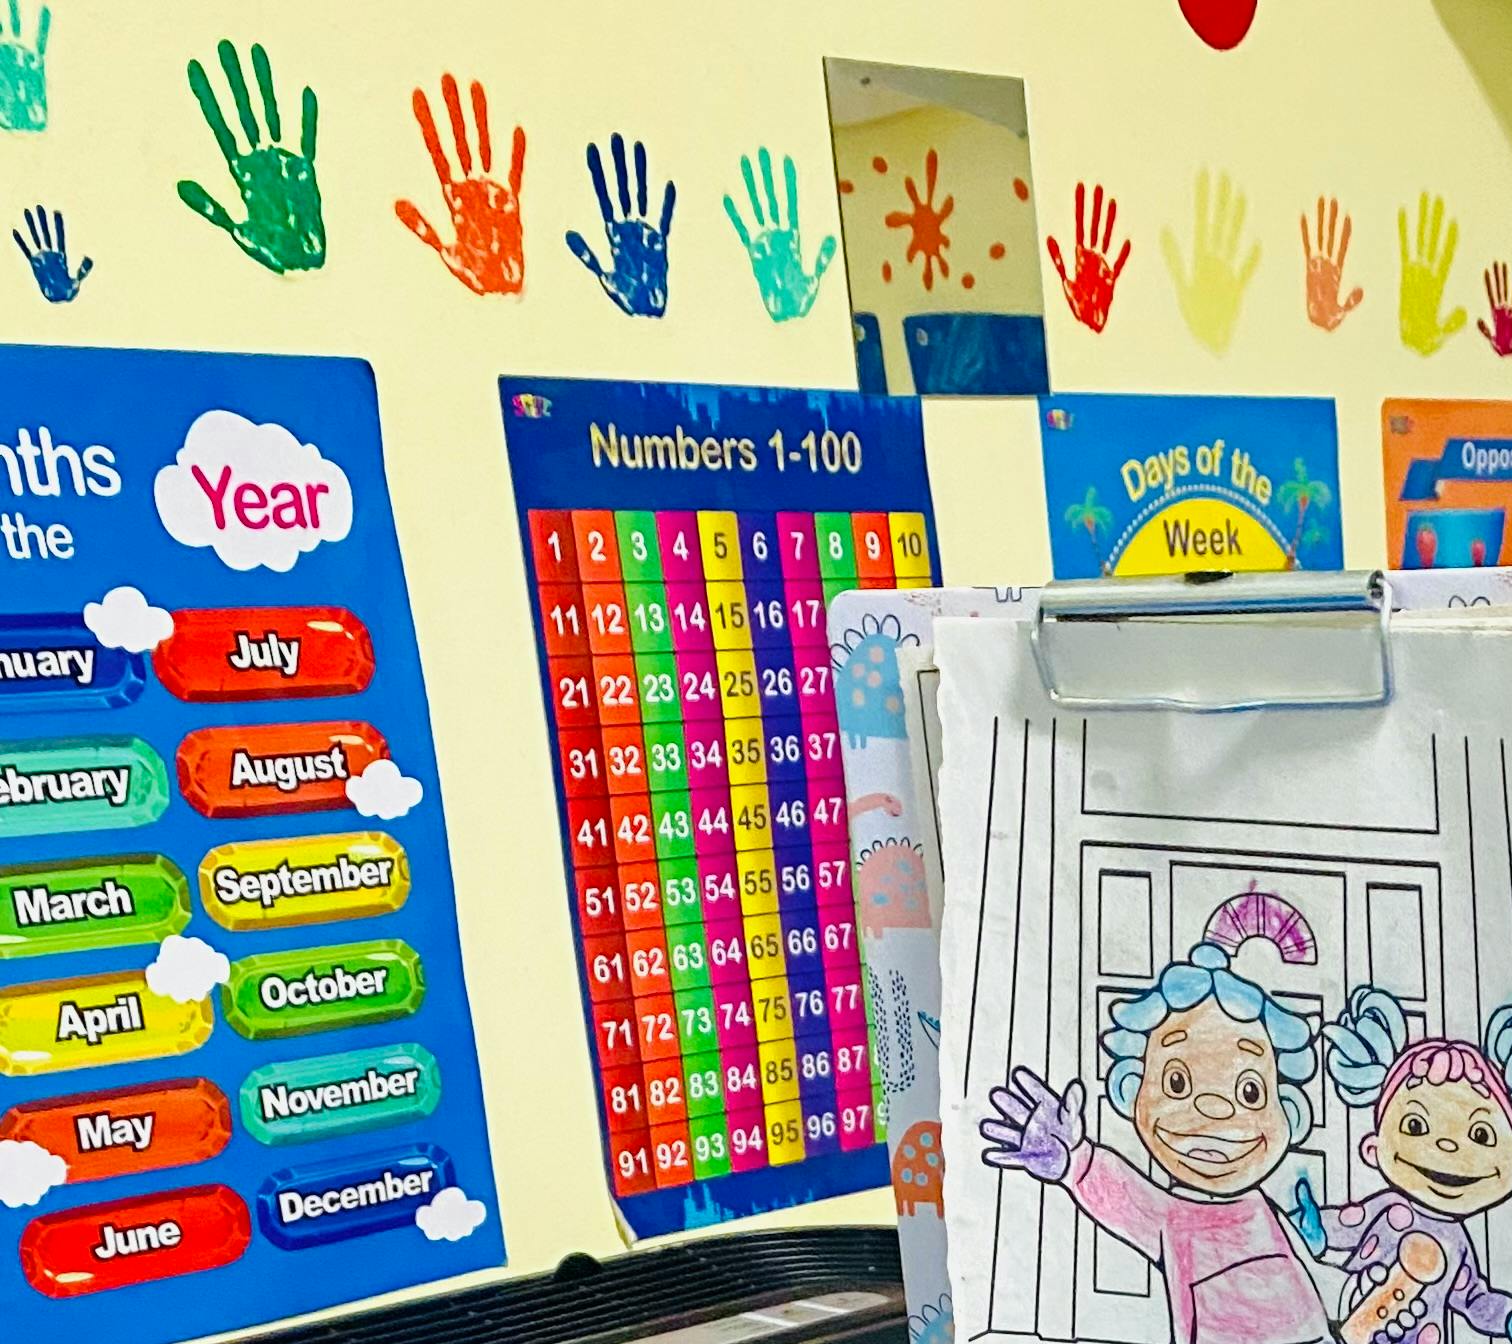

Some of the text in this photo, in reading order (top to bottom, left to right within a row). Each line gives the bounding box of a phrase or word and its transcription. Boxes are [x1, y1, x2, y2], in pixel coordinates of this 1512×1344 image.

[589, 422, 863, 474] Numbers 1-100
[1120, 438, 1273, 506] Days of the
[191, 465, 330, 530] Year
[0, 511, 75, 559] the
[547, 531, 922, 562] 1 2 3 4 5 6 7 8 9 10
[1163, 518, 1243, 558] Week
[550, 599, 820, 635] 11 12 13 14 15 16 17
[230, 634, 299, 673] July
[559, 666, 830, 708] 21 22 23 24 25 26 27
[231, 747, 347, 790] August
[569, 732, 836, 779] 31 32 33 34 35 36 37
[577, 797, 842, 848] 41 42 43 44 45 46 47
[14, 883, 132, 924] March
[217, 858, 392, 906] September
[585, 860, 846, 917] 51 52 53 54 55 56 57
[593, 922, 852, 983] 61 62 63 64 65 66 67
[260, 967, 386, 1009] October
[57, 996, 142, 1043] April
[602, 984, 859, 1049] 71 72 73 74 75 76 77
[260, 1067, 418, 1119] November
[611, 1083, 641, 1113] 81
[649, 1077, 681, 1107] 82
[689, 1070, 720, 1100] 83
[727, 1063, 757, 1092] 84
[765, 1058, 794, 1084] 85
[801, 1050, 831, 1081] 86
[837, 1045, 865, 1073] 87
[77, 1114, 154, 1150] May
[619, 1147, 649, 1178] 91
[656, 1140, 688, 1169] 92
[694, 1132, 726, 1162] 93
[732, 1125, 763, 1154] 94
[770, 1118, 799, 1145] 95
[806, 1111, 836, 1141] 96
[842, 1105, 870, 1132] 97
[279, 1169, 433, 1222] December
[94, 1219, 181, 1258] June
